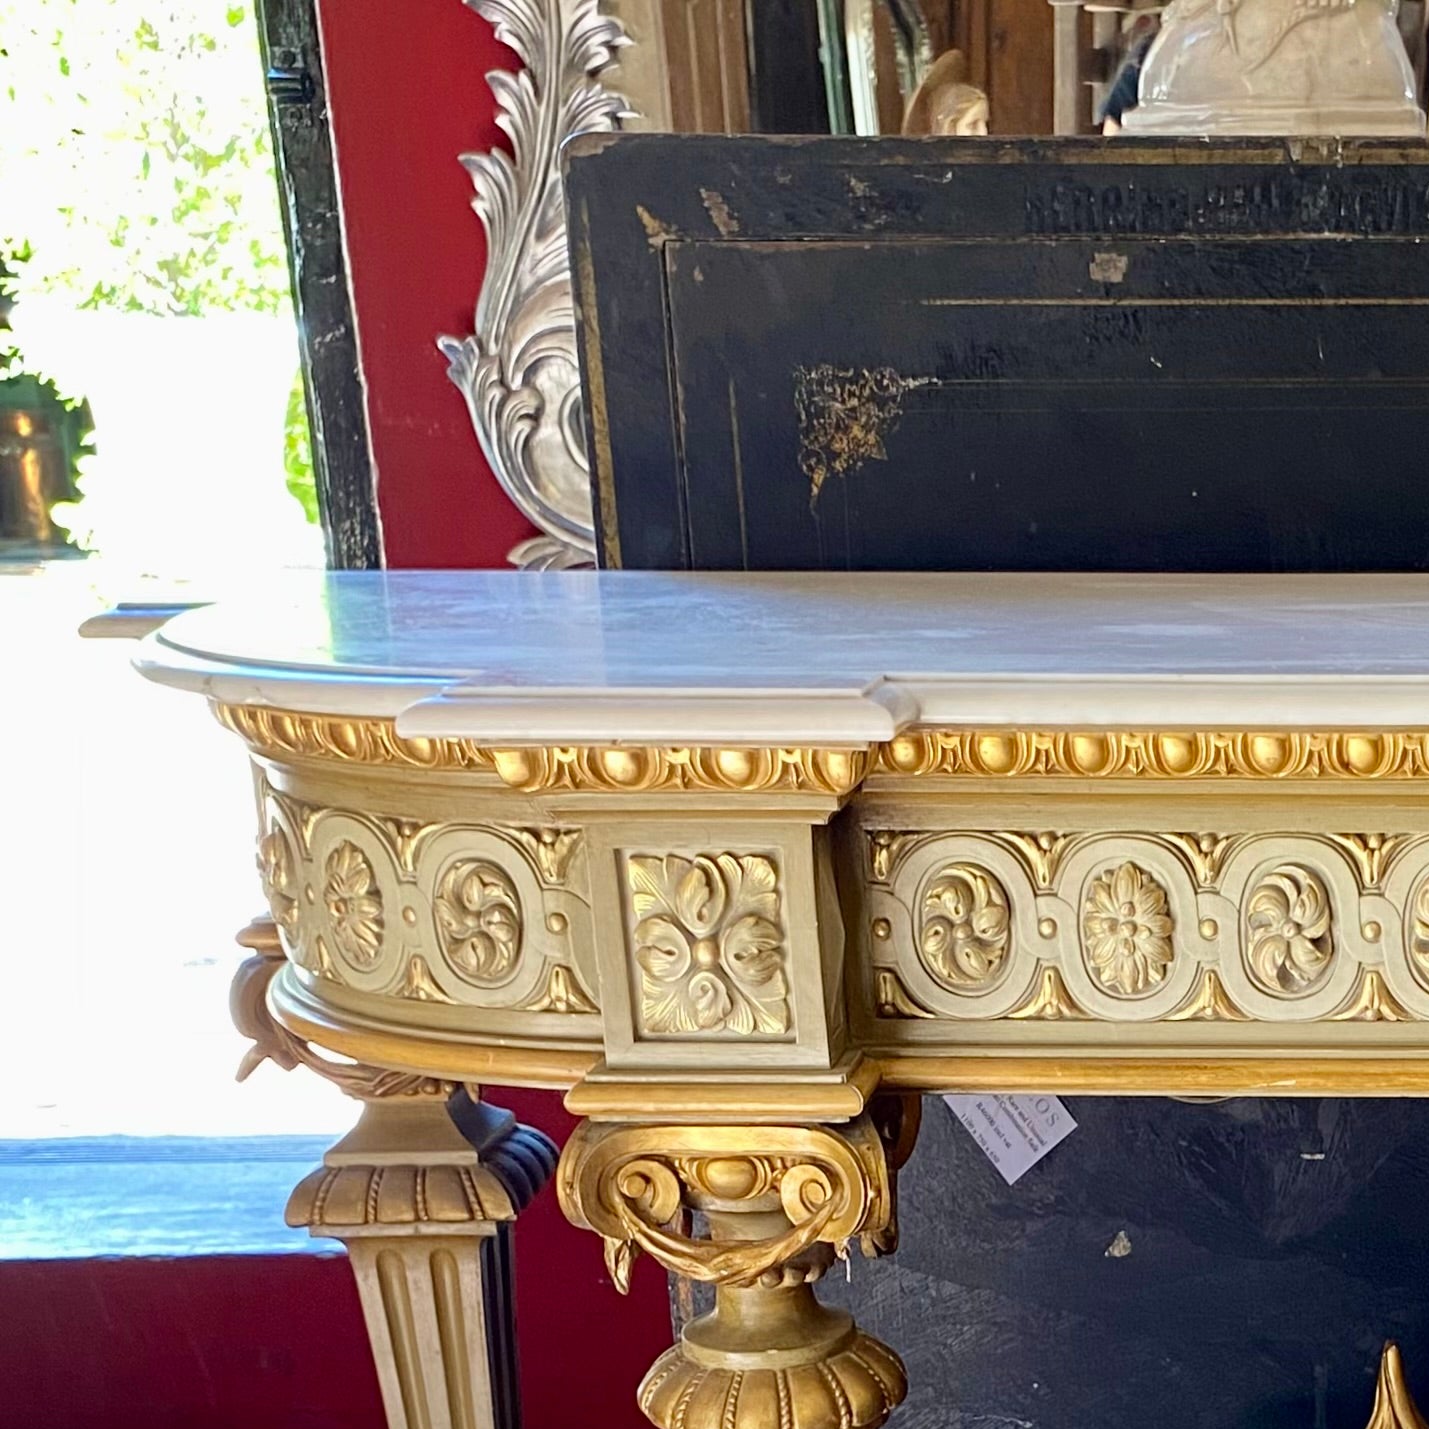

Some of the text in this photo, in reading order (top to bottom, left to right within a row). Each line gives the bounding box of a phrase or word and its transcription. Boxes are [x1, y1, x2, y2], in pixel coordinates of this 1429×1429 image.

[1028, 1096, 1061, 1128] OS
[992, 1124, 1006, 1139] incl
[1001, 1137, 1012, 1149] vat
[1016, 1108, 1030, 1123] and
[1024, 1119, 1048, 1147] Unusual
[1025, 1137, 1040, 1153] Safe
